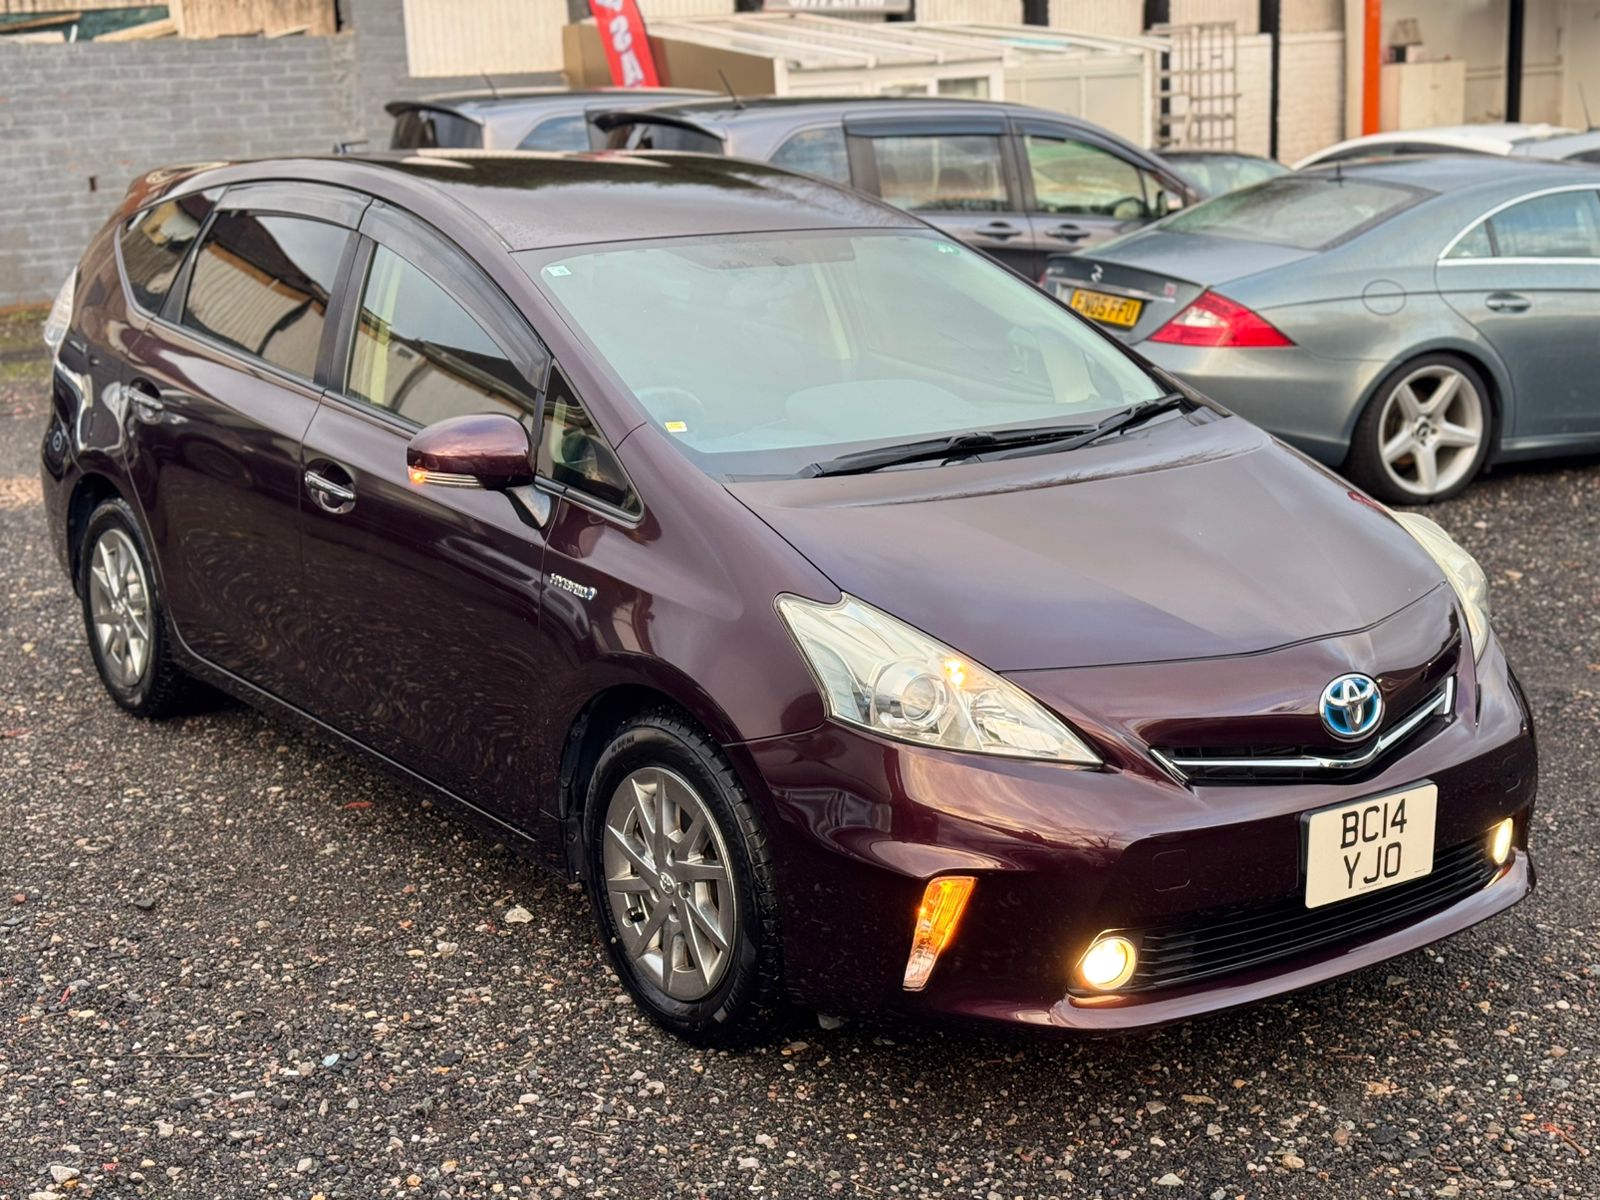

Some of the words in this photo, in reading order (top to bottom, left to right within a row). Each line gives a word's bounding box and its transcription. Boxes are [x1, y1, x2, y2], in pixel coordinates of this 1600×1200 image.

[549, 573, 589, 599] HYBRID
[1340, 798, 1408, 849] BC14
[1343, 841, 1402, 889] YJO
